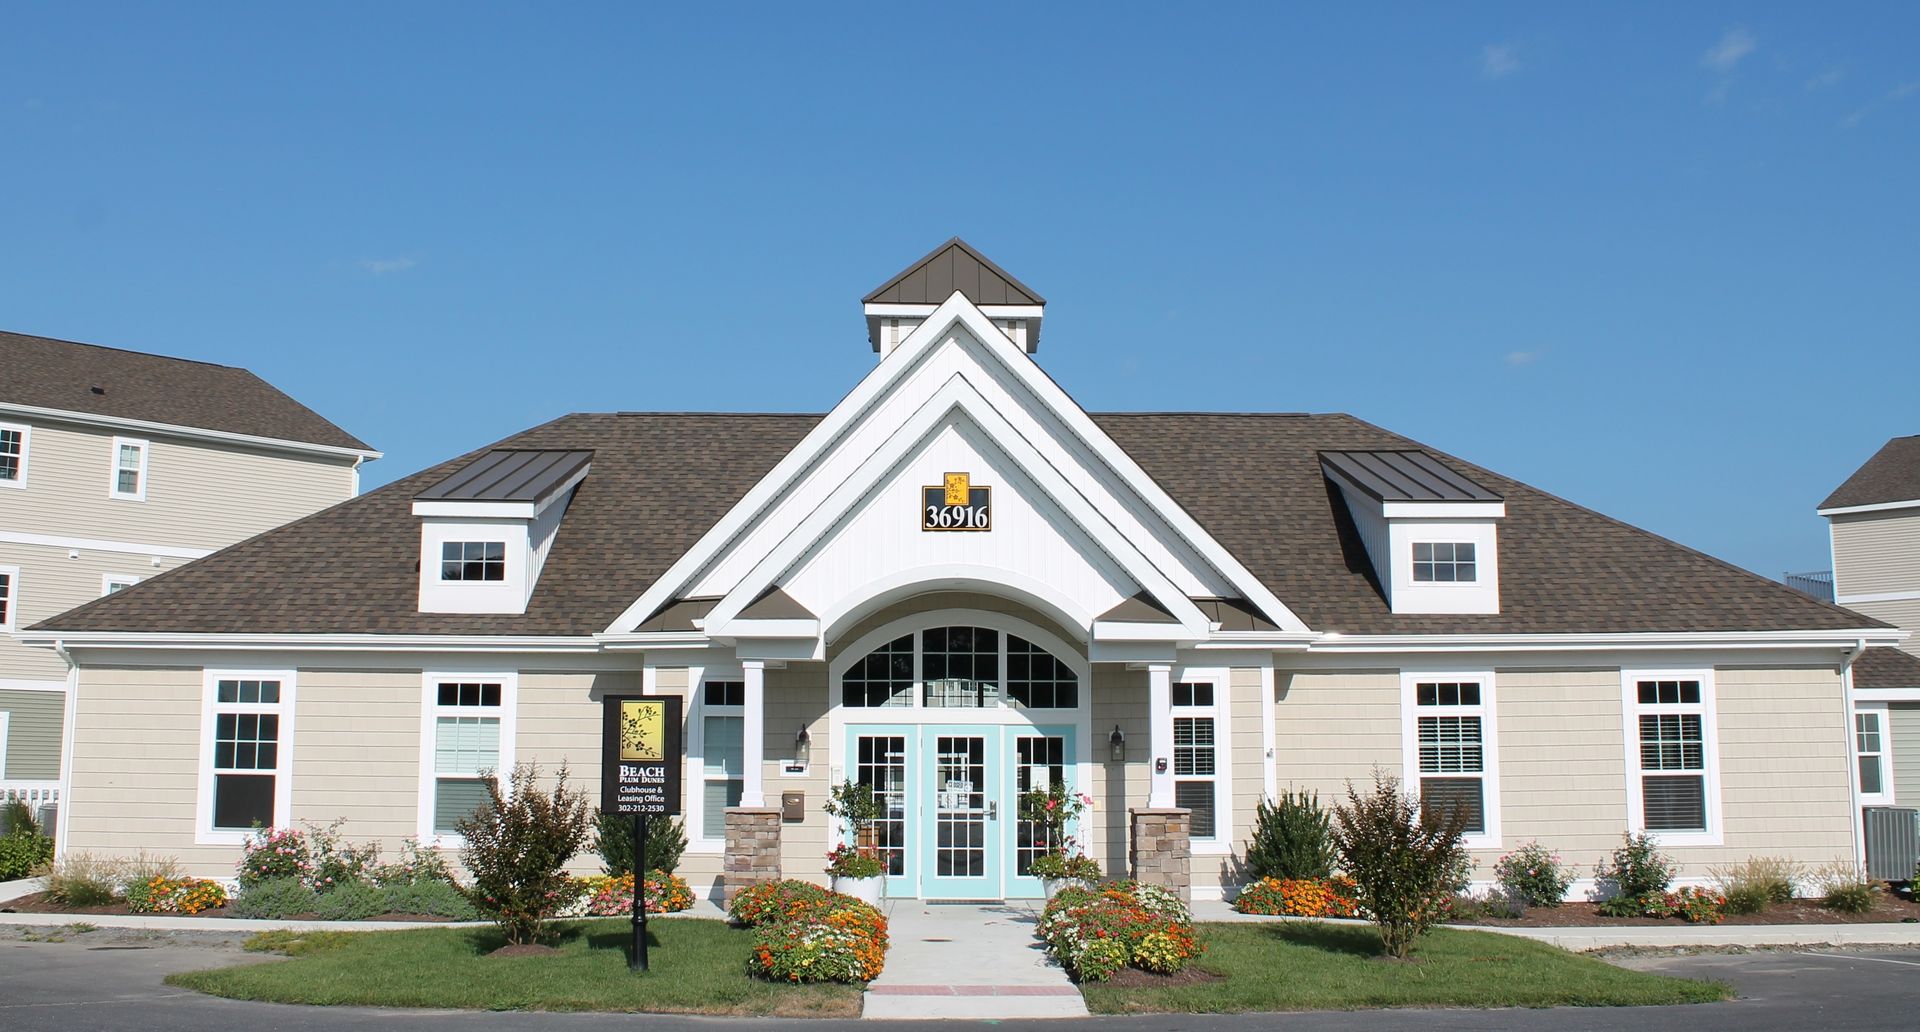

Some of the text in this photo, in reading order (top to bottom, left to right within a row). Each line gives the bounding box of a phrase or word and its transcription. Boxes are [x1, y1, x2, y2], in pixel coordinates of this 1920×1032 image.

[925, 505, 988, 528] 36916
[619, 765, 665, 777] BEACH
[618, 795, 643, 803] Leasing
[618, 804, 665, 812] 302-212-2530
